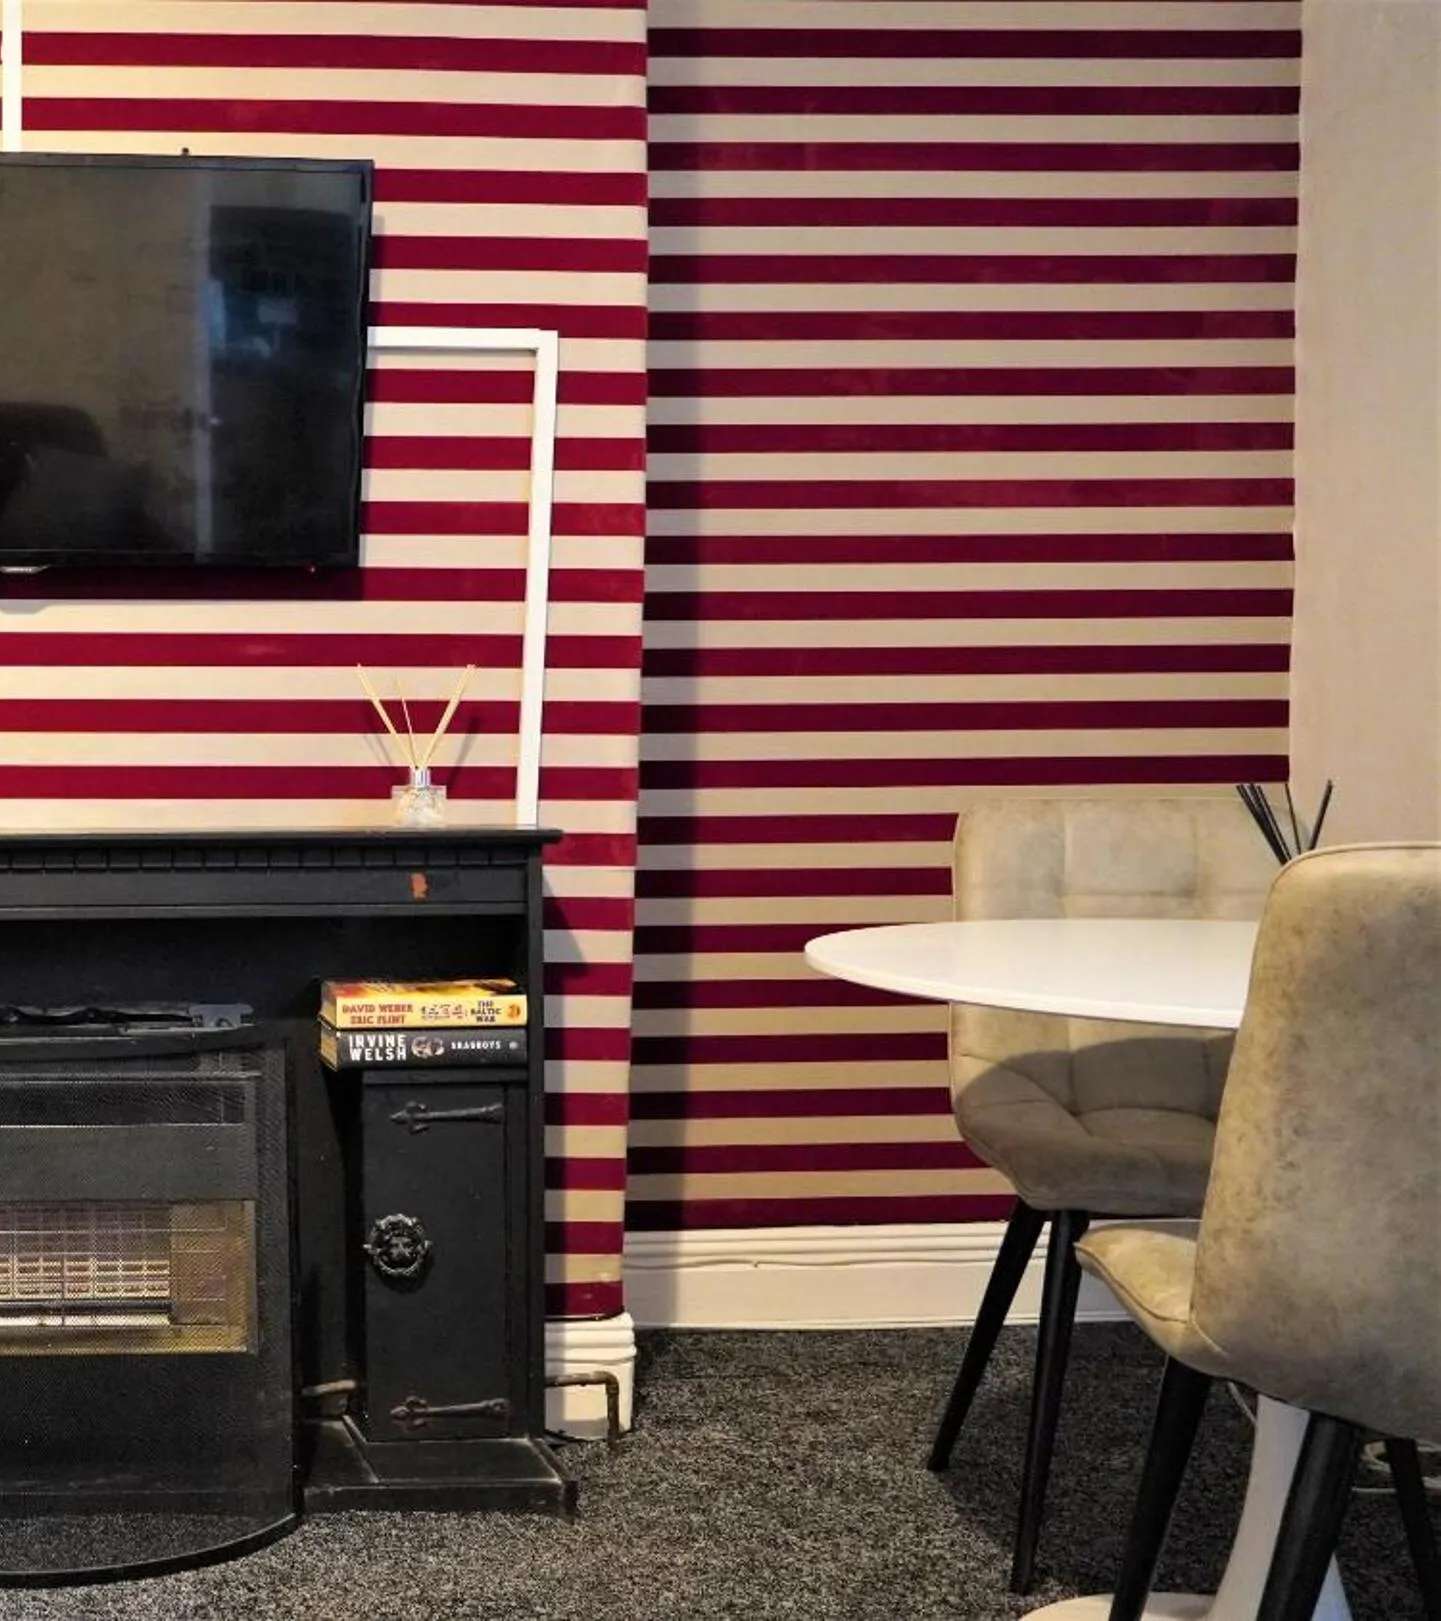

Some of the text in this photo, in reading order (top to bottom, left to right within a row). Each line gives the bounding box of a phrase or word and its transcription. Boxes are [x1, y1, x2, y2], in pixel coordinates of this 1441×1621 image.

[342, 1004, 413, 1013] DAVID WEBER
[470, 1007, 502, 1015] BALTIC
[350, 1015, 406, 1024] ERIC FLINT
[348, 1034, 407, 1048] IRVINE
[349, 1047, 407, 1061] WELSH
